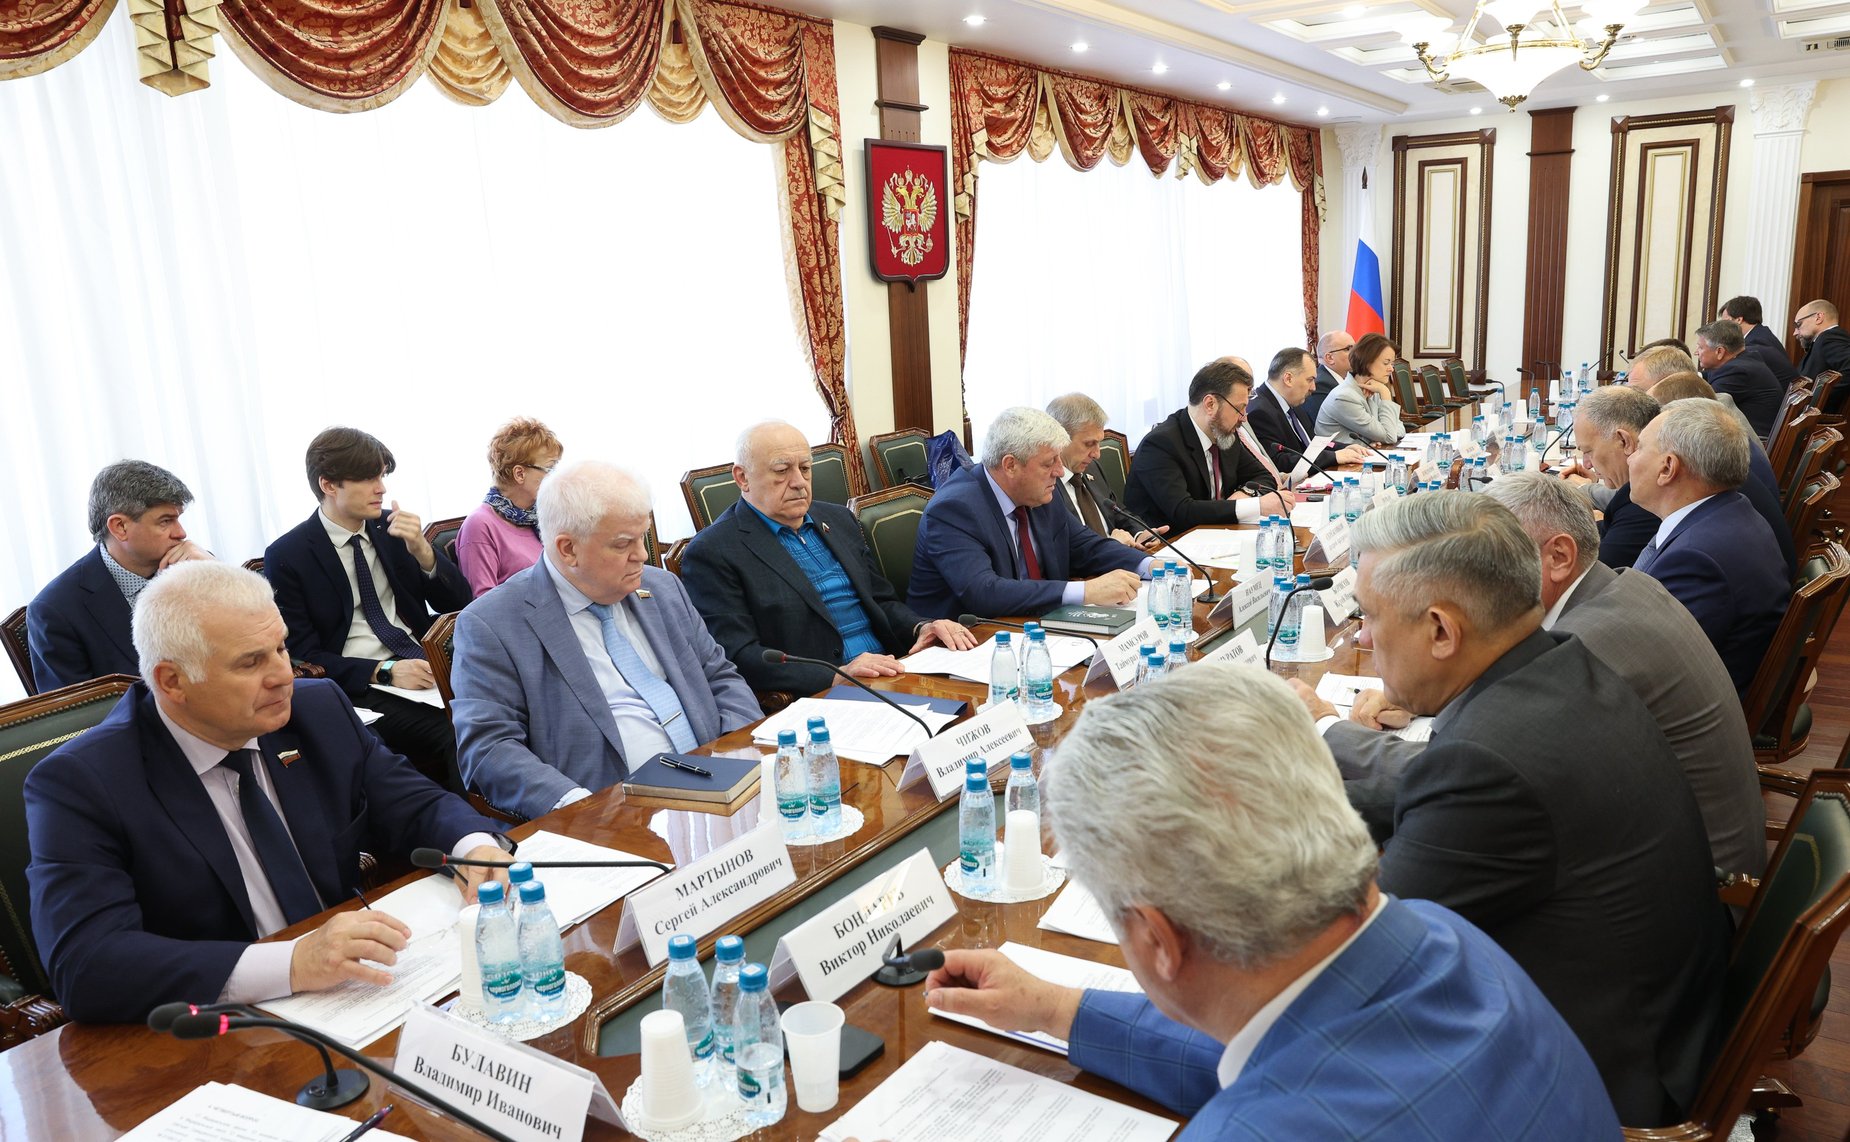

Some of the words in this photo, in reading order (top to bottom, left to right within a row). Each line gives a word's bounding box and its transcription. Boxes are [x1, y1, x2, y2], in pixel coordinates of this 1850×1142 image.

[1118, 629, 1149, 652] МАМСУРОВ
[1217, 644, 1244, 661] УРАТОВ
[936, 750, 979, 778] Владимир
[980, 727, 1022, 754] Алексеевич
[955, 723, 991, 747] ЧИЖОВ
[654, 903, 698, 935] Сергей
[701, 857, 783, 911] Александрович
[675, 849, 754, 901] МАРТЫНОВ
[819, 940, 867, 976] Виктор
[866, 895, 935, 946] Николаевич
[451, 1044, 532, 1093] БУЛАВИН
[413, 1056, 482, 1105] Владимир
[487, 1089, 562, 1140] Иванович
